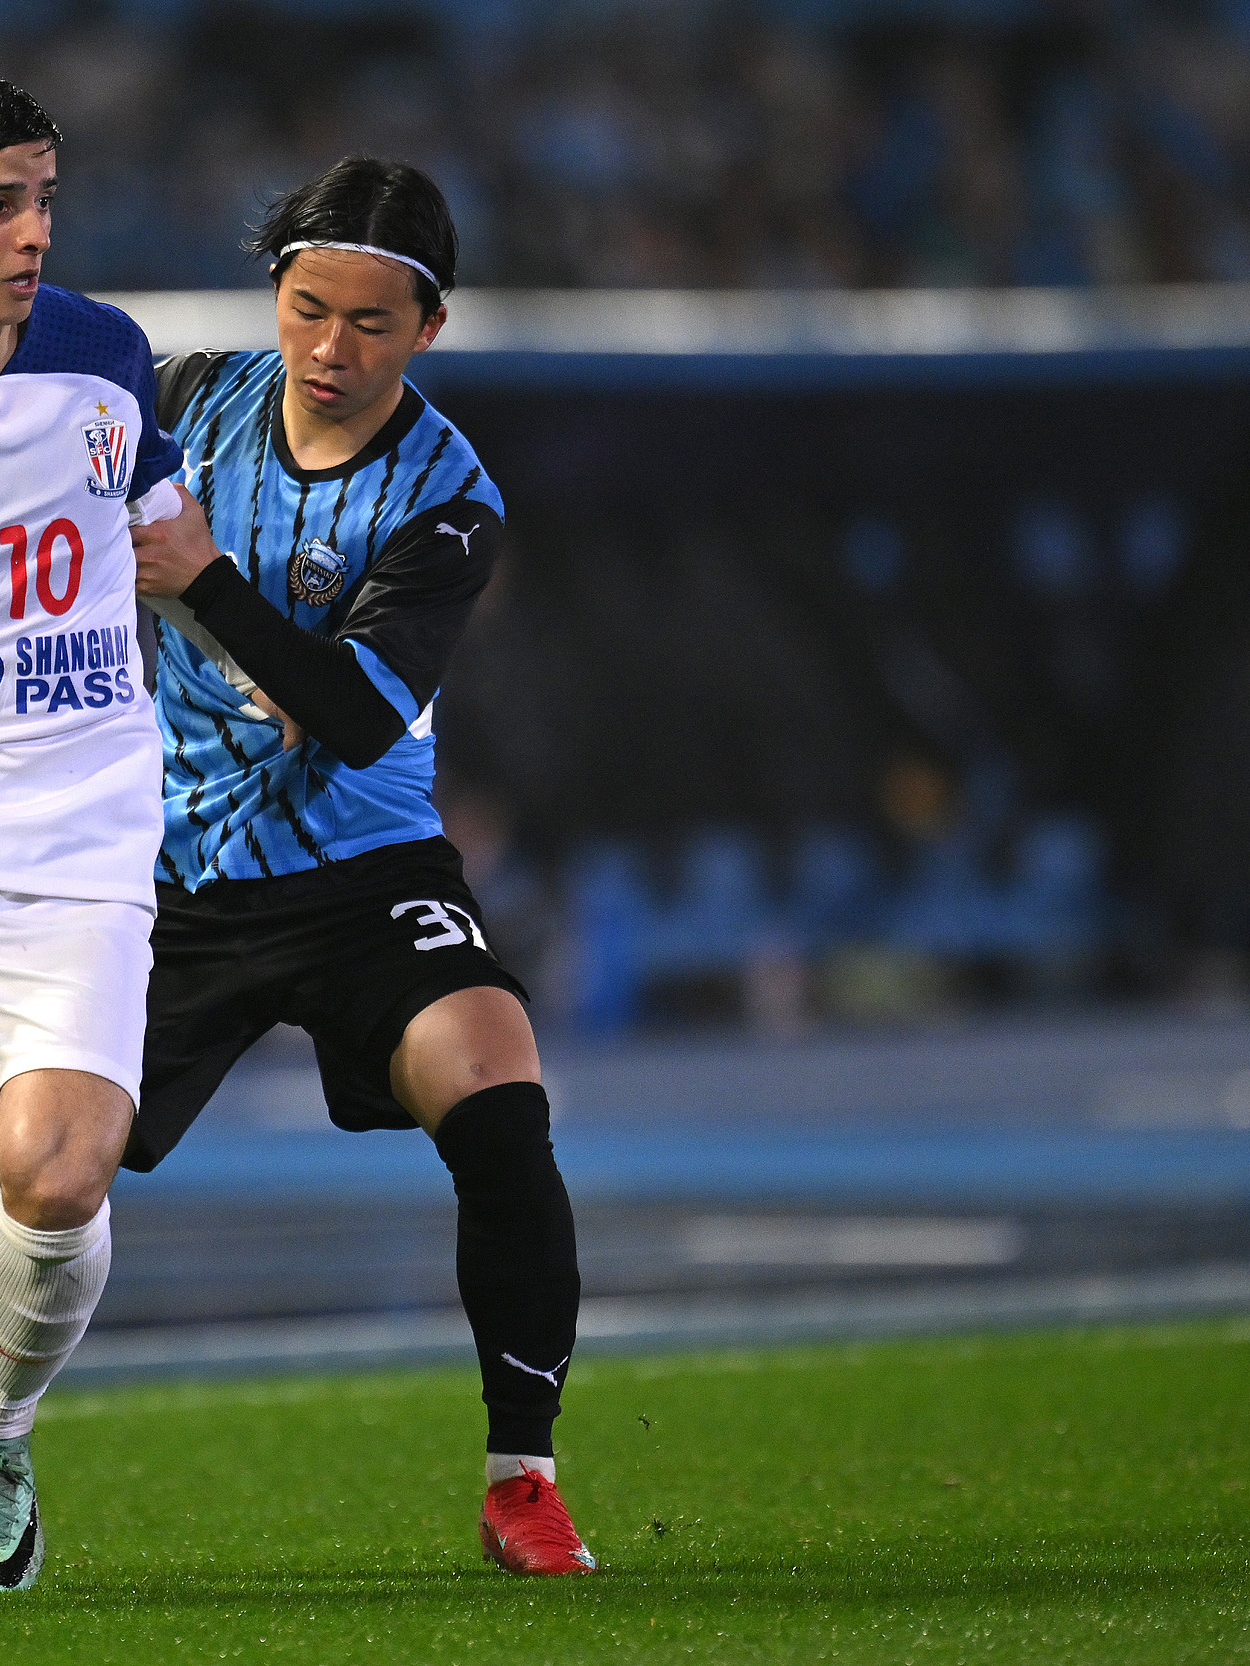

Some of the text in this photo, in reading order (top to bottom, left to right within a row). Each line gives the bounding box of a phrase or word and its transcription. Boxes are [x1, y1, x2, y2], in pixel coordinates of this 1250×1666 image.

[90, 446, 111, 455] SFC
[16, 625, 129, 677] SHANGHAI
[16, 667, 135, 715] PASS
